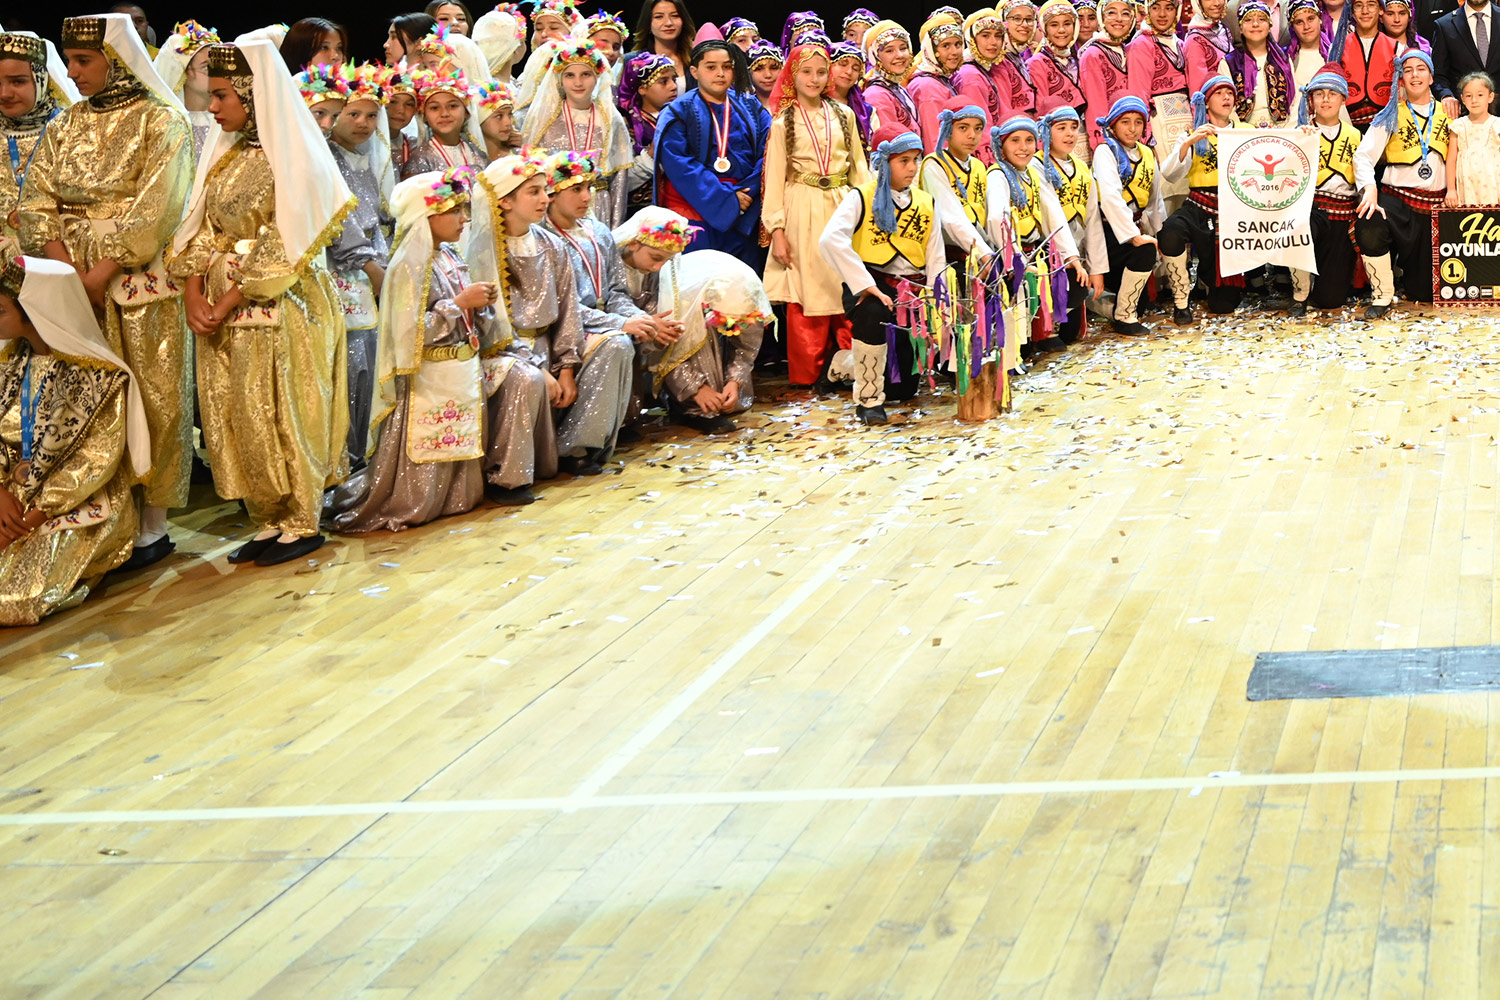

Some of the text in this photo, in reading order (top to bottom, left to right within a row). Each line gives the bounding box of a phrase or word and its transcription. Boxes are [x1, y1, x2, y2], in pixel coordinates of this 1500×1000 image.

[1250, 137, 1282, 147] SANCAK
[1281, 140, 1309, 174] ORTAOKULU
[1261, 184, 1280, 192] 2016
[1238, 219, 1295, 233] SANCAK
[1222, 234, 1310, 251] ORTAOKULU
[1448, 262, 1460, 278] 1.
